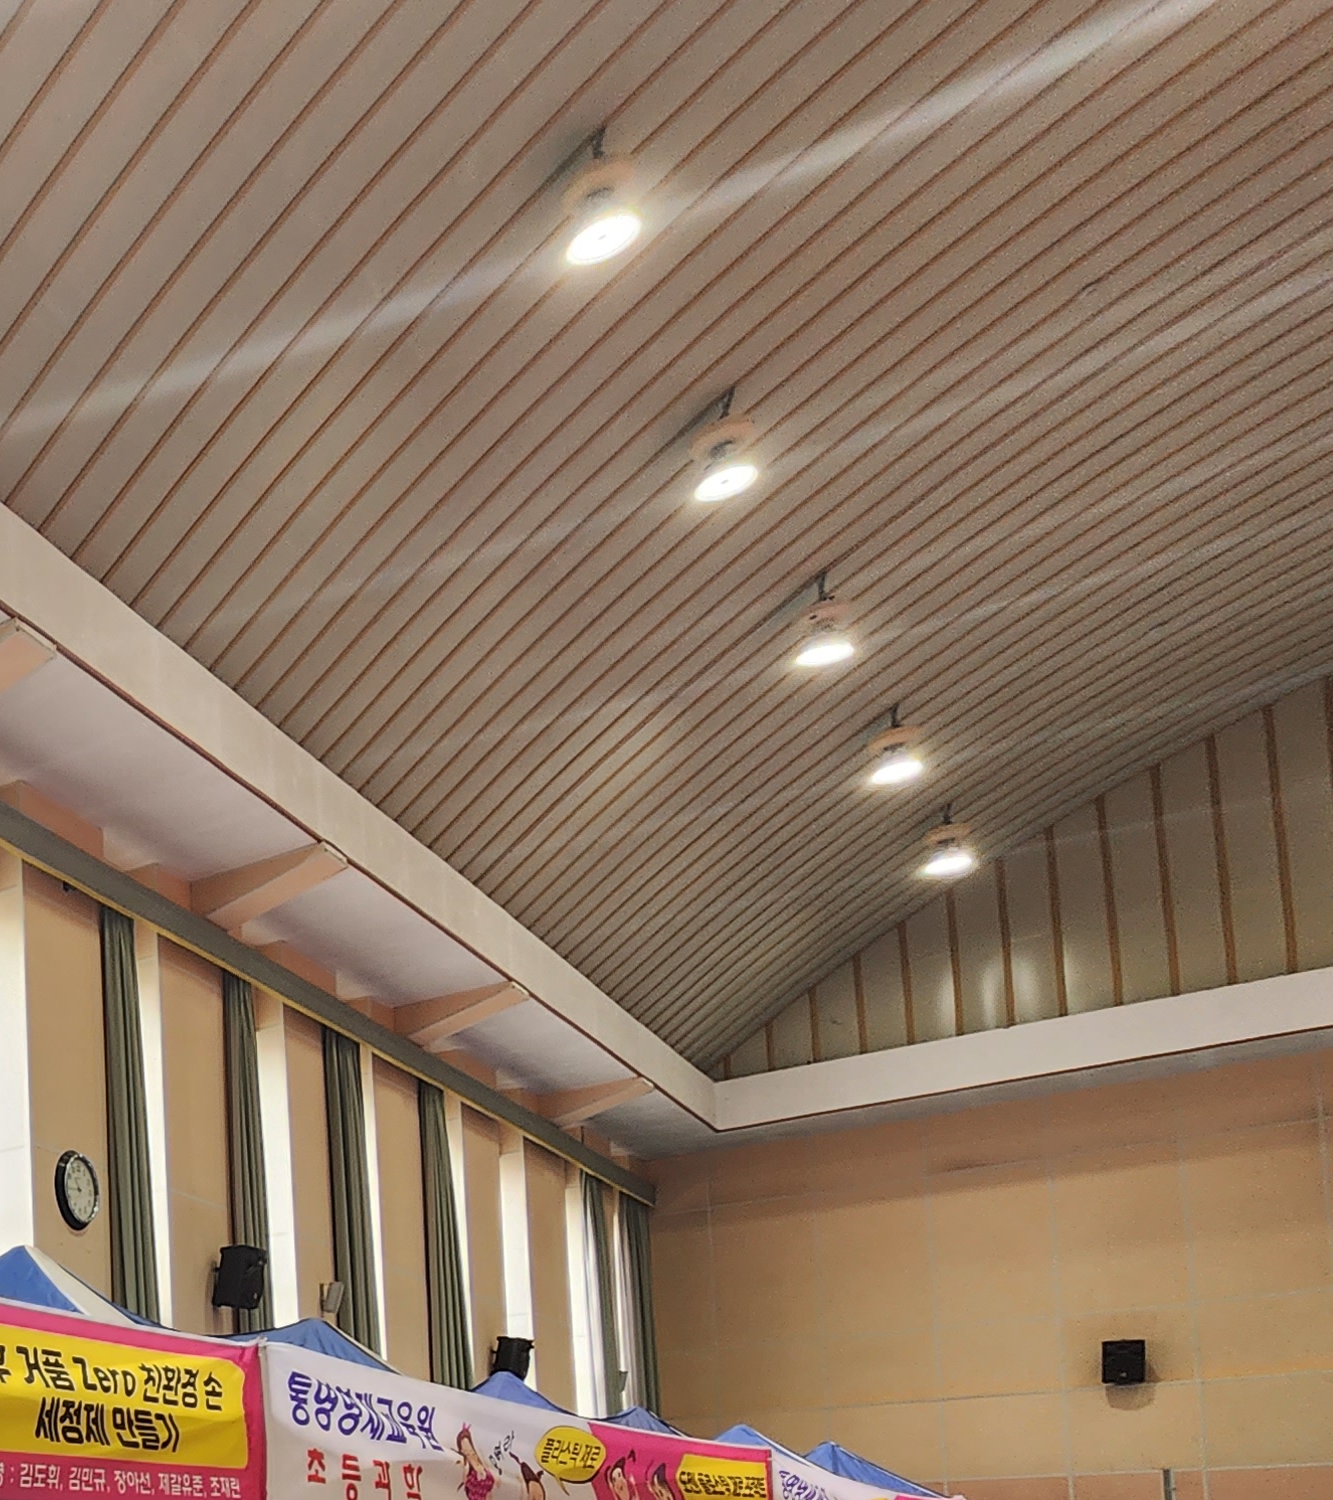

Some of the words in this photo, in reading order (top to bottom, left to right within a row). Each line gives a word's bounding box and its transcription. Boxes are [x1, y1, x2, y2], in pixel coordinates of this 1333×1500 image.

[15, 1345, 74, 1394] 거품
[73, 1356, 137, 1399] Zero
[142, 1362, 199, 1410] 친환경
[203, 1370, 224, 1413] 손
[34, 1397, 111, 1448] 세정제
[112, 1413, 182, 1454] 만들기
